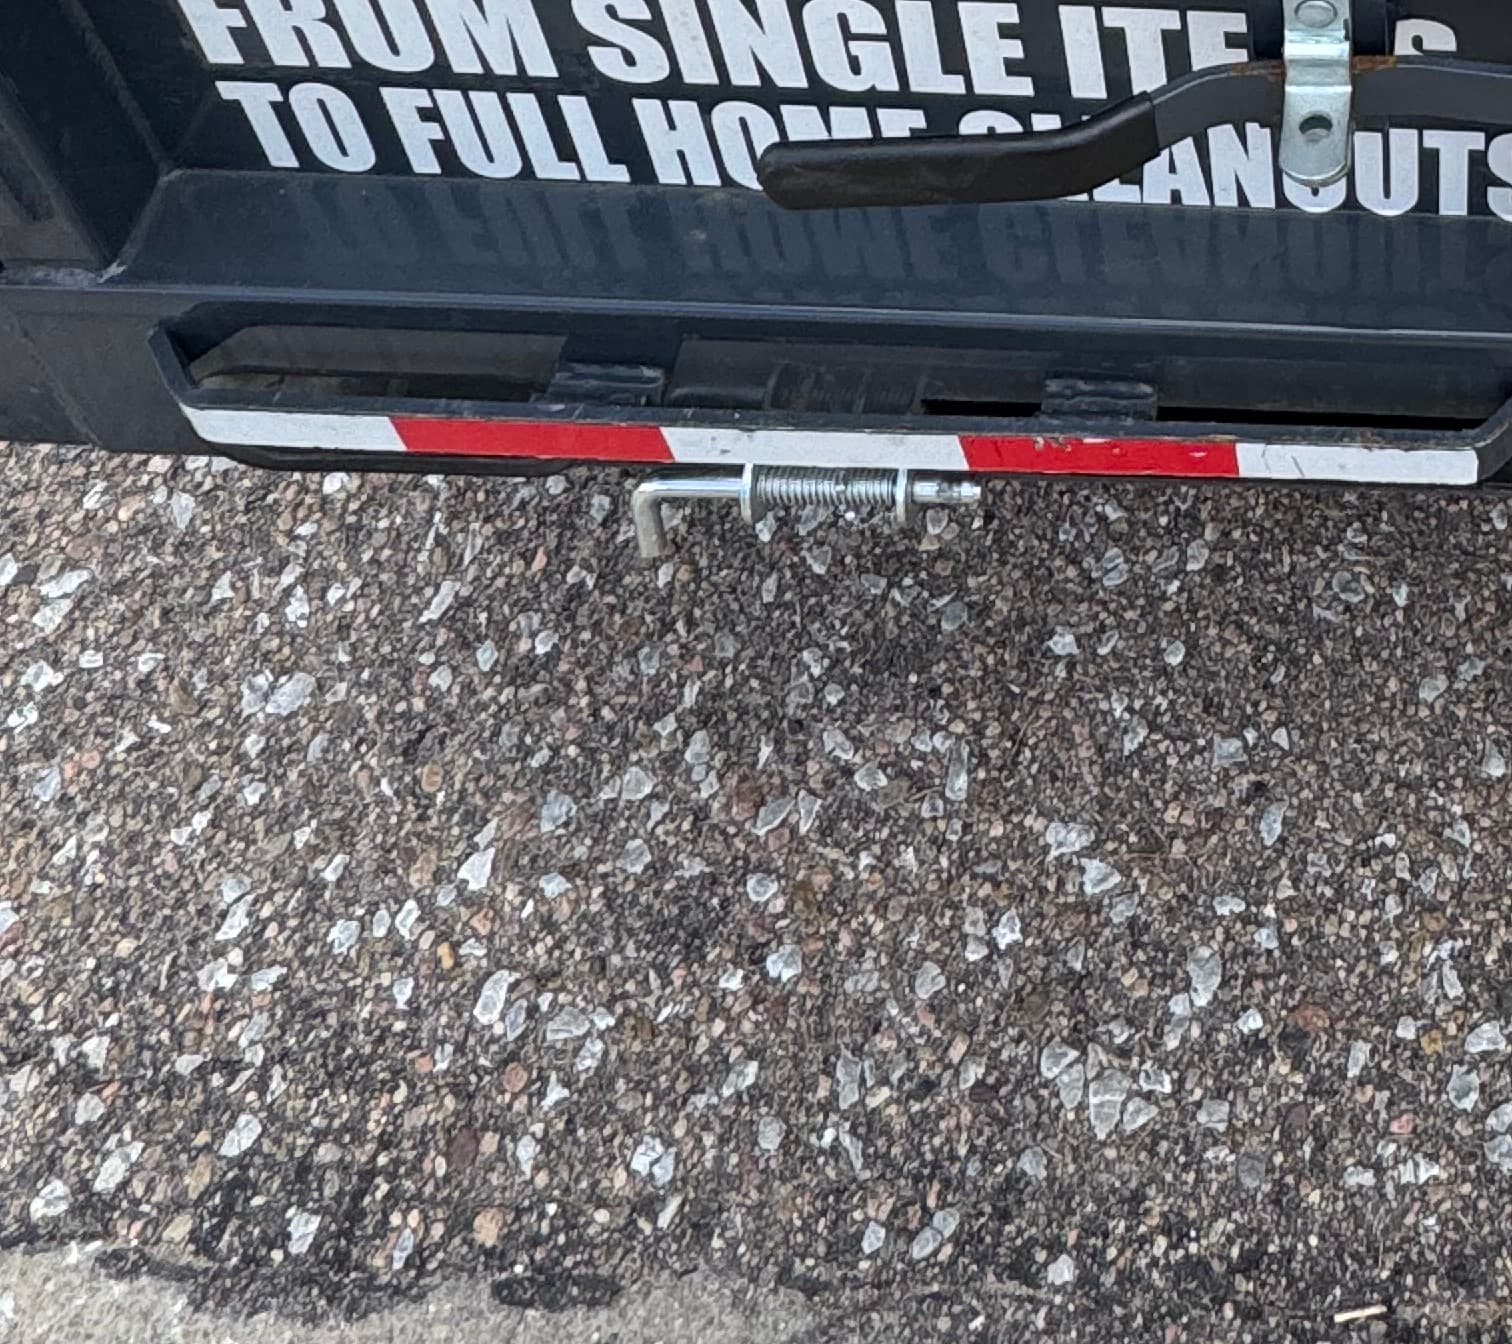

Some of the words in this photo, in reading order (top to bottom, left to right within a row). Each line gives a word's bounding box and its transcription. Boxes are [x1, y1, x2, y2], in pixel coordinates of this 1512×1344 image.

[1058, 4, 1458, 100] ITE
[214, 80, 377, 174] TO
[379, 86, 632, 184] FULL
